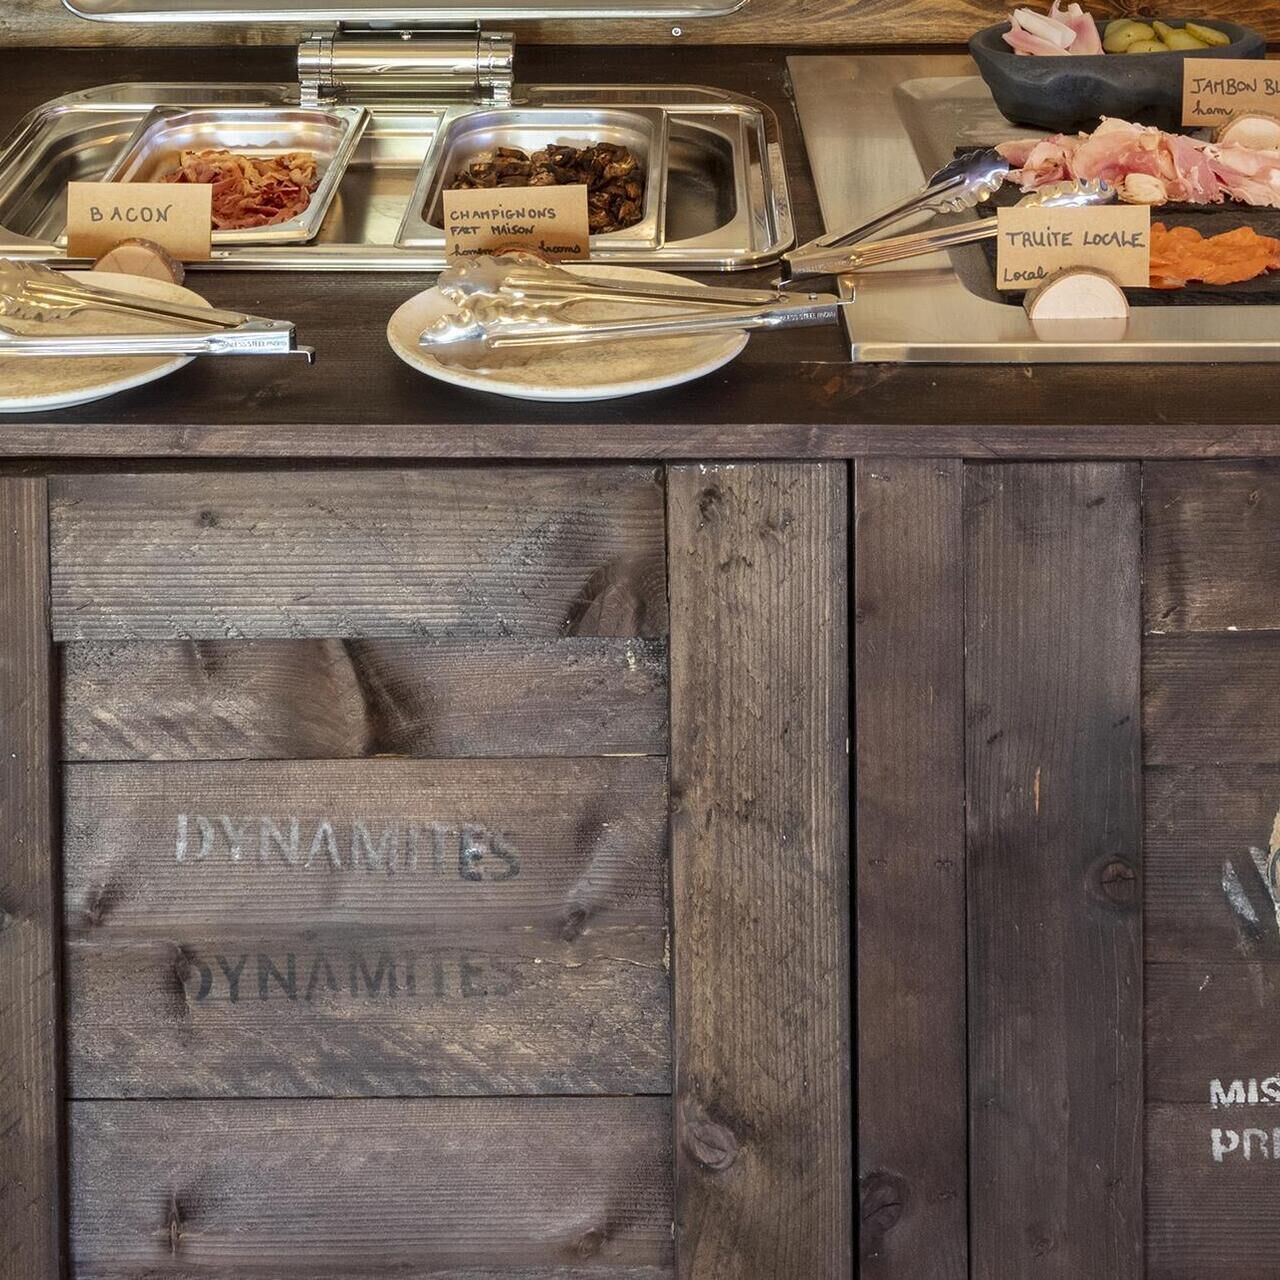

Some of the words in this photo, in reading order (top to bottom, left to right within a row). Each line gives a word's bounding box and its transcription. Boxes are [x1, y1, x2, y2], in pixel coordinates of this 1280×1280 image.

[1190, 78, 1257, 96] JAMBON
[1192, 100, 1234, 116] ham
[90, 204, 173, 222] BACON
[450, 204, 557, 221] CHAMPIGNONS
[491, 223, 535, 236] MAISON
[1005, 226, 1073, 248] TRUITE
[1083, 231, 1146, 248] LOCALE
[1004, 265, 1049, 283] Local
[174, 813, 521, 882] DYNAMITES
